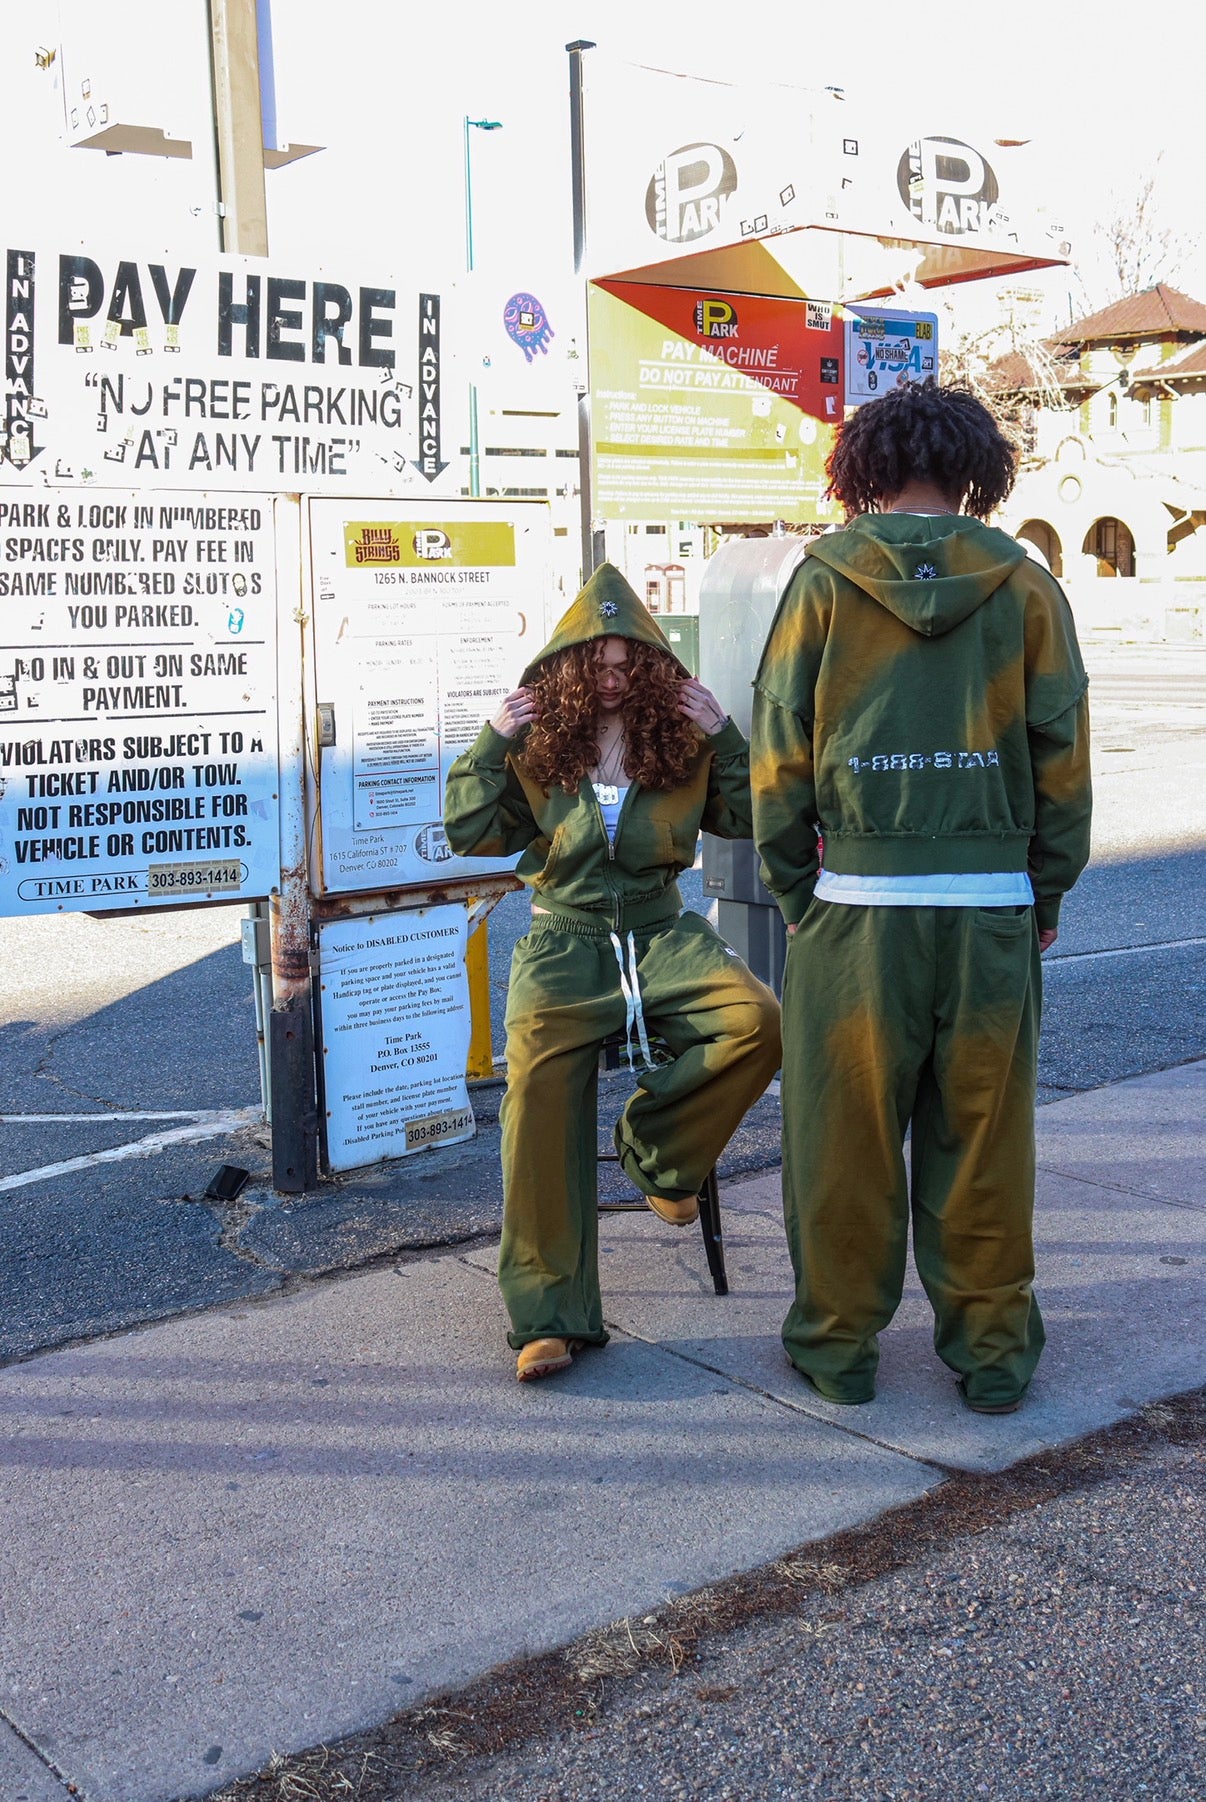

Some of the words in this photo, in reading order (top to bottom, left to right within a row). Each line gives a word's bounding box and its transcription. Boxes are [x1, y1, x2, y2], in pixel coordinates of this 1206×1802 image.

[922, 139, 997, 232] PARK
[12, 257, 30, 298] IN
[58, 254, 197, 346] PAY
[217, 271, 396, 369] HERE
[422, 299, 437, 335] IN
[703, 300, 740, 338] PARK
[808, 302, 831, 315] WHO
[814, 312, 823, 321] IS
[807, 319, 830, 330] SMUT
[661, 341, 697, 361] PAY
[699, 344, 778, 367] MACHINE
[876, 348, 885, 360] NO
[885, 348, 909, 361] SHAME
[9, 312, 32, 438] ADVANC
[640, 368, 661, 384] DO
[664, 369, 693, 385] NOT
[695, 371, 720, 387] PAY
[721, 374, 798, 392] ATTENDANT
[162, 377, 252, 420] FREE
[261, 383, 402, 429] PARKING
[421, 346, 438, 474] ADVANCE
[610, 402, 629, 411] PARK
[631, 403, 647, 412] AND
[648, 404, 669, 413] LOCK
[637, 414, 653, 423] ANY
[187, 432, 263, 472] ANY
[0, 503, 50, 528] PARK
[56, 504, 71, 528] &
[78, 505, 127, 529] LOCK
[134, 506, 153, 529] IN
[159, 507, 262, 531] NUMBERED
[361, 529, 393, 545] BILLY
[421, 530, 453, 559] PARK
[5, 537, 85, 562] SPACES
[92, 538, 146, 562] ONLY.
[153, 539, 188, 562] PAY
[196, 540, 227, 562] FEE
[234, 540, 254, 563] IN
[355, 545, 401, 563] STRINGS
[0, 572, 57, 596] SAME
[183, 572, 230, 595] SLOT
[374, 573, 396, 584] 1265
[398, 572, 409, 584] N.
[410, 572, 456, 584] BANNOCK
[457, 571, 491, 583] STREET
[67, 605, 108, 629] YOU
[115, 604, 199, 628] PARKED.
[459, 636, 493, 645] ENFORCEMENT
[53, 657, 75, 681] IN
[82, 656, 101, 681] &
[106, 654, 147, 679] OUT
[190, 652, 248, 677] SAME
[83, 684, 187, 711] PAYMENT.
[367, 699, 389, 707] PAYMENT
[0, 738, 116, 766] VIOLATORS
[123, 733, 213, 761] SUBJECT
[219, 731, 244, 755] TO
[25, 771, 99, 799] TICKET
[107, 766, 185, 794] AND/OR
[192, 763, 242, 787] TOW.
[358, 780, 380, 788] PARKING
[381, 778, 402, 786] CONTACT
[403, 775, 435, 784] INFORMATION
[17, 805, 61, 831] NOT
[69, 796, 205, 828] RESPONSIBLE
[211, 793, 248, 819] FOR
[14, 835, 99, 864] VEHICLE
[107, 833, 134, 857] OR
[142, 824, 252, 854] CONTENTS.
[352, 837, 369, 846] Time
[369, 834, 385, 844] Park
[330, 852, 346, 861] 1615
[347, 848, 379, 859] California
[380, 846, 388, 855] ST
[378, 858, 398, 869] 80202
[35, 879, 85, 897] TIME
[91, 875, 139, 892] PARK
[152, 868, 238, 888] 303-893-1414
[332, 943, 355, 954] Notice
[356, 942, 364, 950] to
[366, 935, 409, 948] DISABLED
[410, 926, 459, 941] CUSTOMERS
[333, 989, 362, 999] Handicap
[362, 987, 372, 995] tag
[380, 983, 395, 993] plate
[395, 978, 424, 989] displayed,
[424, 976, 435, 984] and
[435, 974, 446, 982] you
[341, 976, 364, 987] parking
[365, 975, 381, 985] space
[382, 972, 393, 980] and
[394, 971, 406, 980] your
[407, 967, 426, 976] vehicle
[442, 962, 456, 970] valid
[334, 1022, 353, 1032] within
[353, 1020, 368, 1029] three
[369, 1016, 392, 1026] business
[392, 1014, 405, 1023] days
[412, 1011, 421, 1019] the
[421, 1007, 446, 1017] following
[347, 1012, 358, 1021] you
[358, 1010, 371, 1019] may
[372, 1008, 383, 1017] pay
[383, 1006, 398, 1015] your
[398, 1001, 421, 1012] parking
[421, 999, 433, 1007] fees
[433, 998, 440, 1006] by
[441, 996, 454, 1004] mail
[377, 1049, 392, 1058] P.O.
[394, 1047, 408, 1056] Box
[410, 1041, 431, 1052] 13555
[385, 1036, 403, 1045] Time
[405, 1031, 422, 1041] Park
[370, 1062, 399, 1073] Denver,
[400, 1057, 415, 1067] CO
[416, 1053, 438, 1064] 80201
[351, 1102, 365, 1111] stall
[390, 1096, 401, 1104] and
[401, 1092, 421, 1102] license
[421, 1090, 436, 1099] plate
[436, 1085, 458, 1093] number
[408, 1112, 473, 1144] 303-893-1414
